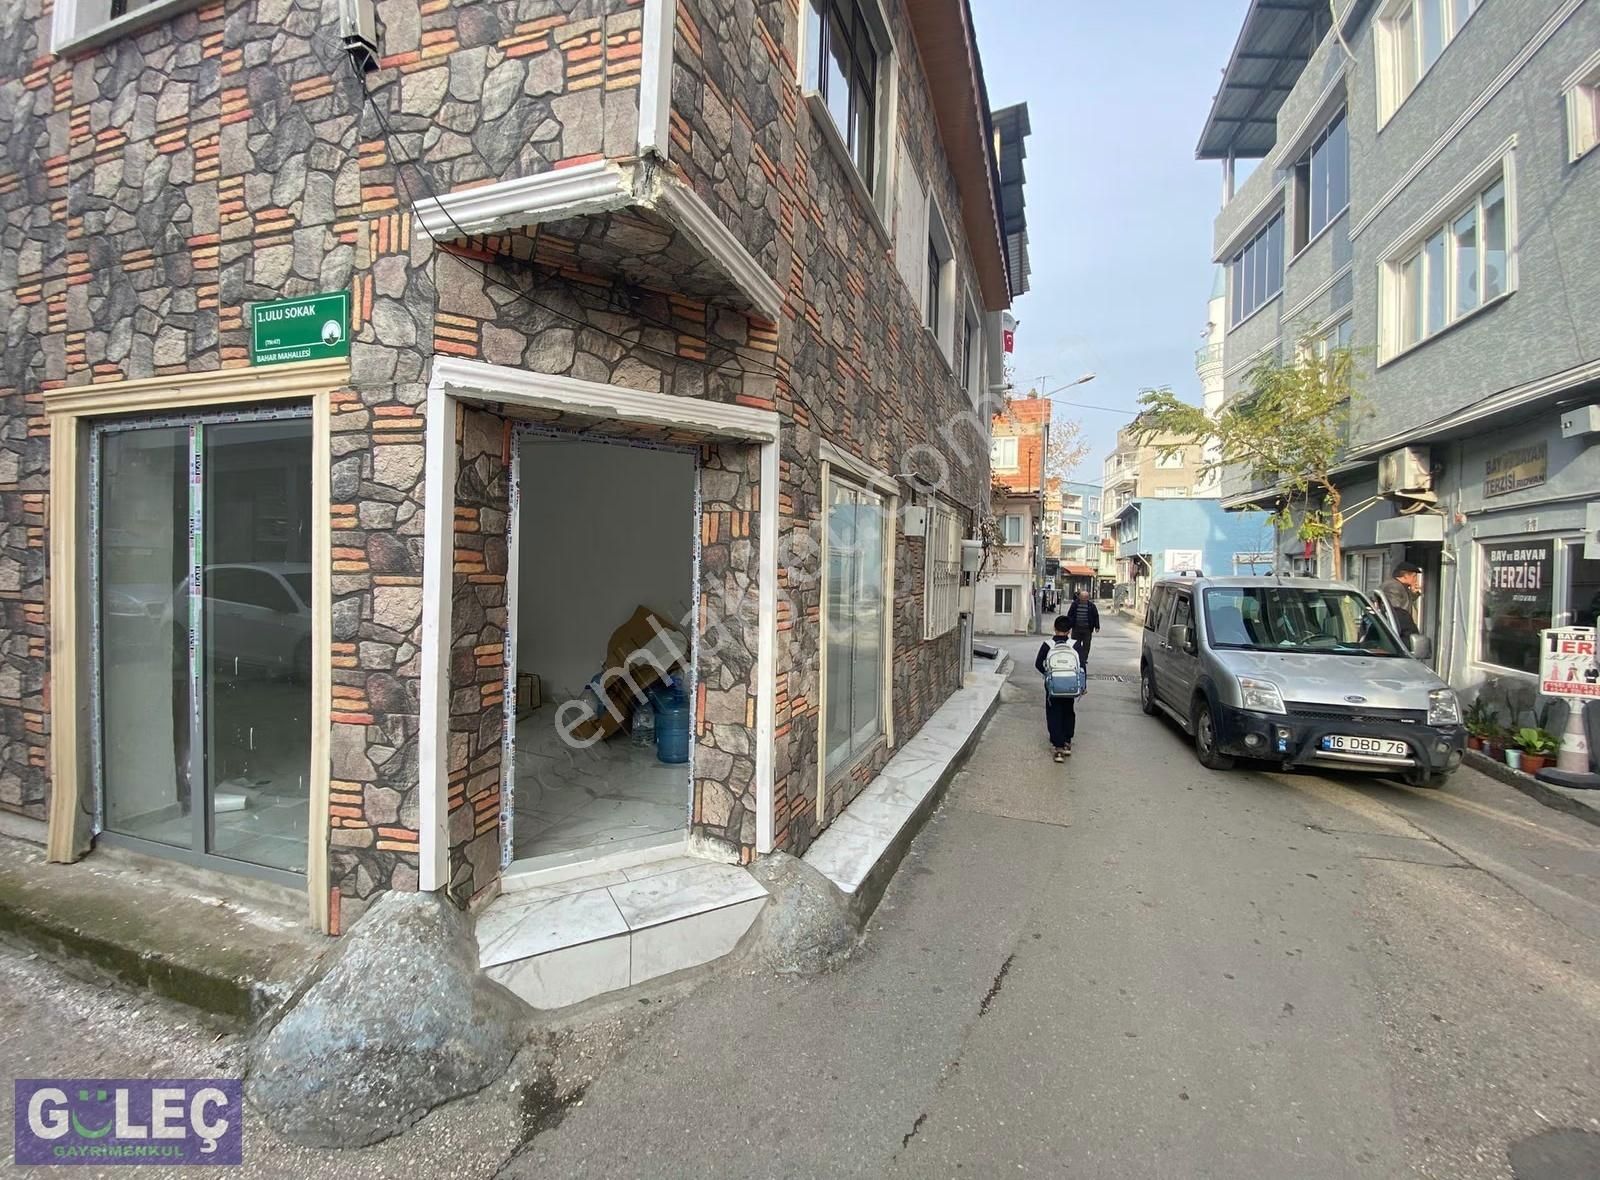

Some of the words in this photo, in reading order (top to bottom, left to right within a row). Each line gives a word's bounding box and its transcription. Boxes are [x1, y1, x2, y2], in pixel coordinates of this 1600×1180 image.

[257, 310, 283, 322] 1.ULU
[285, 305, 316, 319] SOKAK
[256, 353, 277, 363] BAHAR
[277, 348, 311, 360] MAHALLESİ
[1491, 550, 1507, 561] BAY
[1513, 549, 1546, 560] BAYAN
[1493, 561, 1541, 589] TERZİSİ
[1331, 736, 1344, 748] 16
[1350, 738, 1381, 752] DBD
[1387, 742, 1404, 754] 76
